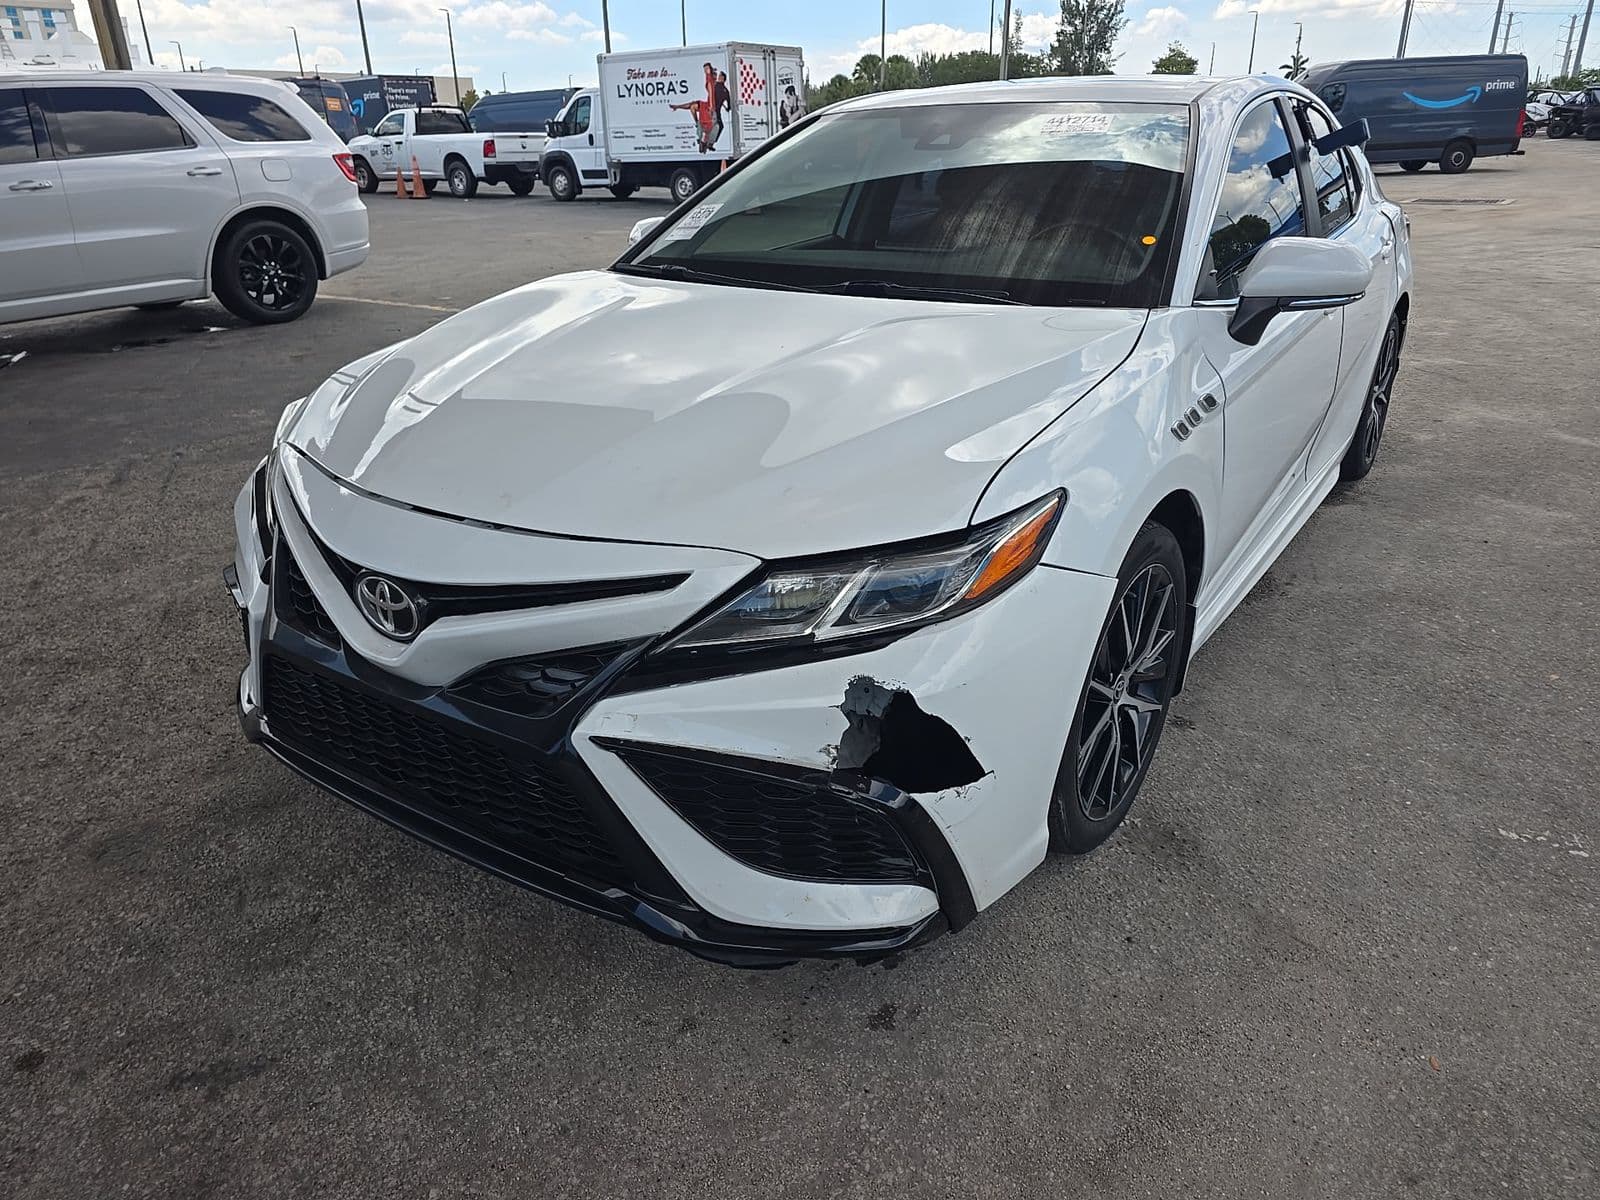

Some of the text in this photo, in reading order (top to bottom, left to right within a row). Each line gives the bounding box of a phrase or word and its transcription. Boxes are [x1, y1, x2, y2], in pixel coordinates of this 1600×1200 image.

[627, 68, 646, 80] Take
[647, 70, 659, 79] me
[617, 80, 689, 98] LYNORA'S
[1485, 79, 1516, 93] prime
[363, 90, 380, 102] prime
